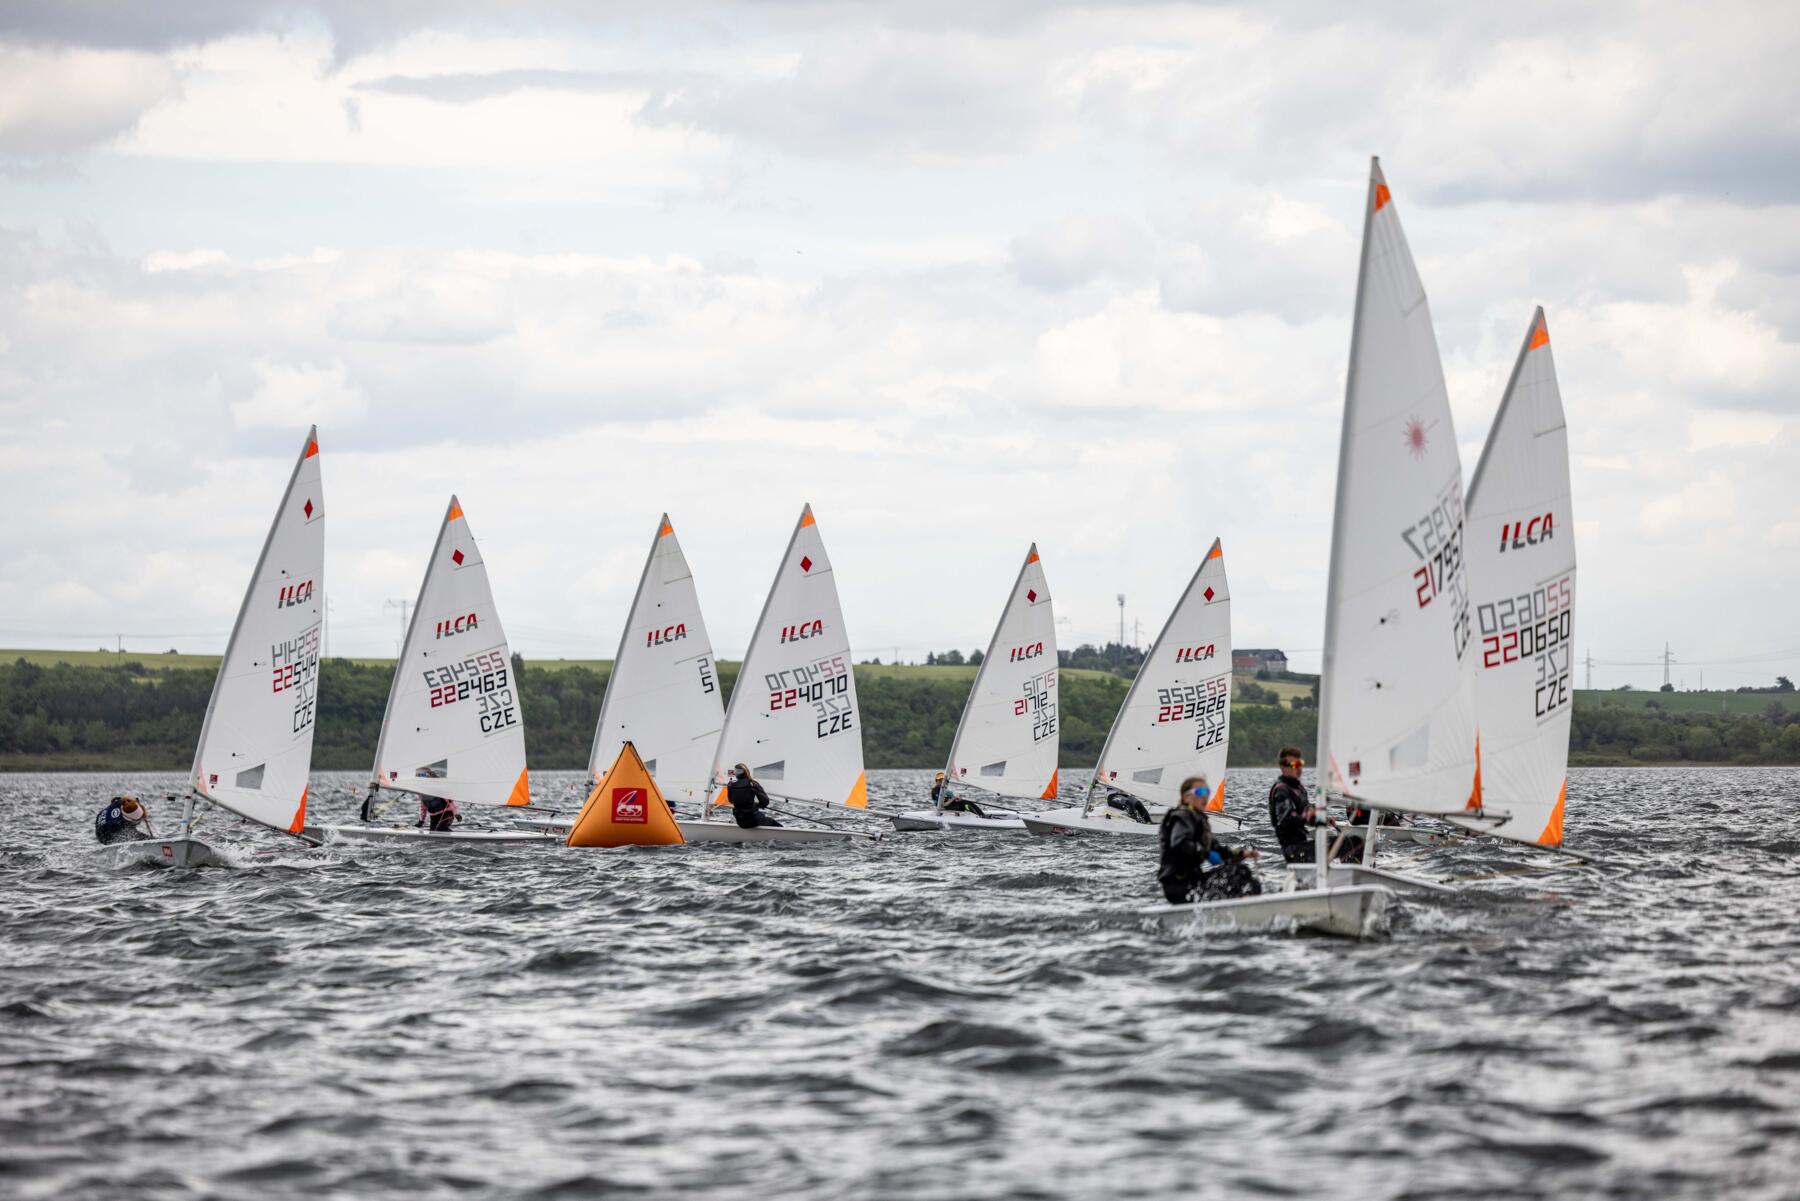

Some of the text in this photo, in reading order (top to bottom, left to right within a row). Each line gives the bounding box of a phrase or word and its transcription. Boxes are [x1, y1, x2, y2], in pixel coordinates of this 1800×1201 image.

[1499, 512, 1553, 553] ILCA
[278, 580, 313, 609] ILCA
[436, 613, 478, 640] ILCA
[647, 623, 687, 648] ILCA
[781, 619, 823, 644] ILCA
[1482, 609, 1570, 669] 220650
[1010, 642, 1043, 662] ILCA
[1176, 644, 1215, 663] ILCA
[273, 652, 317, 693] 225414
[702, 675, 714, 694] 5
[431, 669, 507, 708] 222463
[770, 674, 848, 711] 224070
[1535, 673, 1569, 717] CZE
[293, 701, 313, 733] CZE
[1014, 691, 1047, 716] 21712
[1158, 693, 1227, 722] 223526
[480, 707, 516, 733] CZE
[818, 711, 852, 739] CZE
[1033, 718, 1056, 741] CZE
[1196, 726, 1225, 750] CZE
